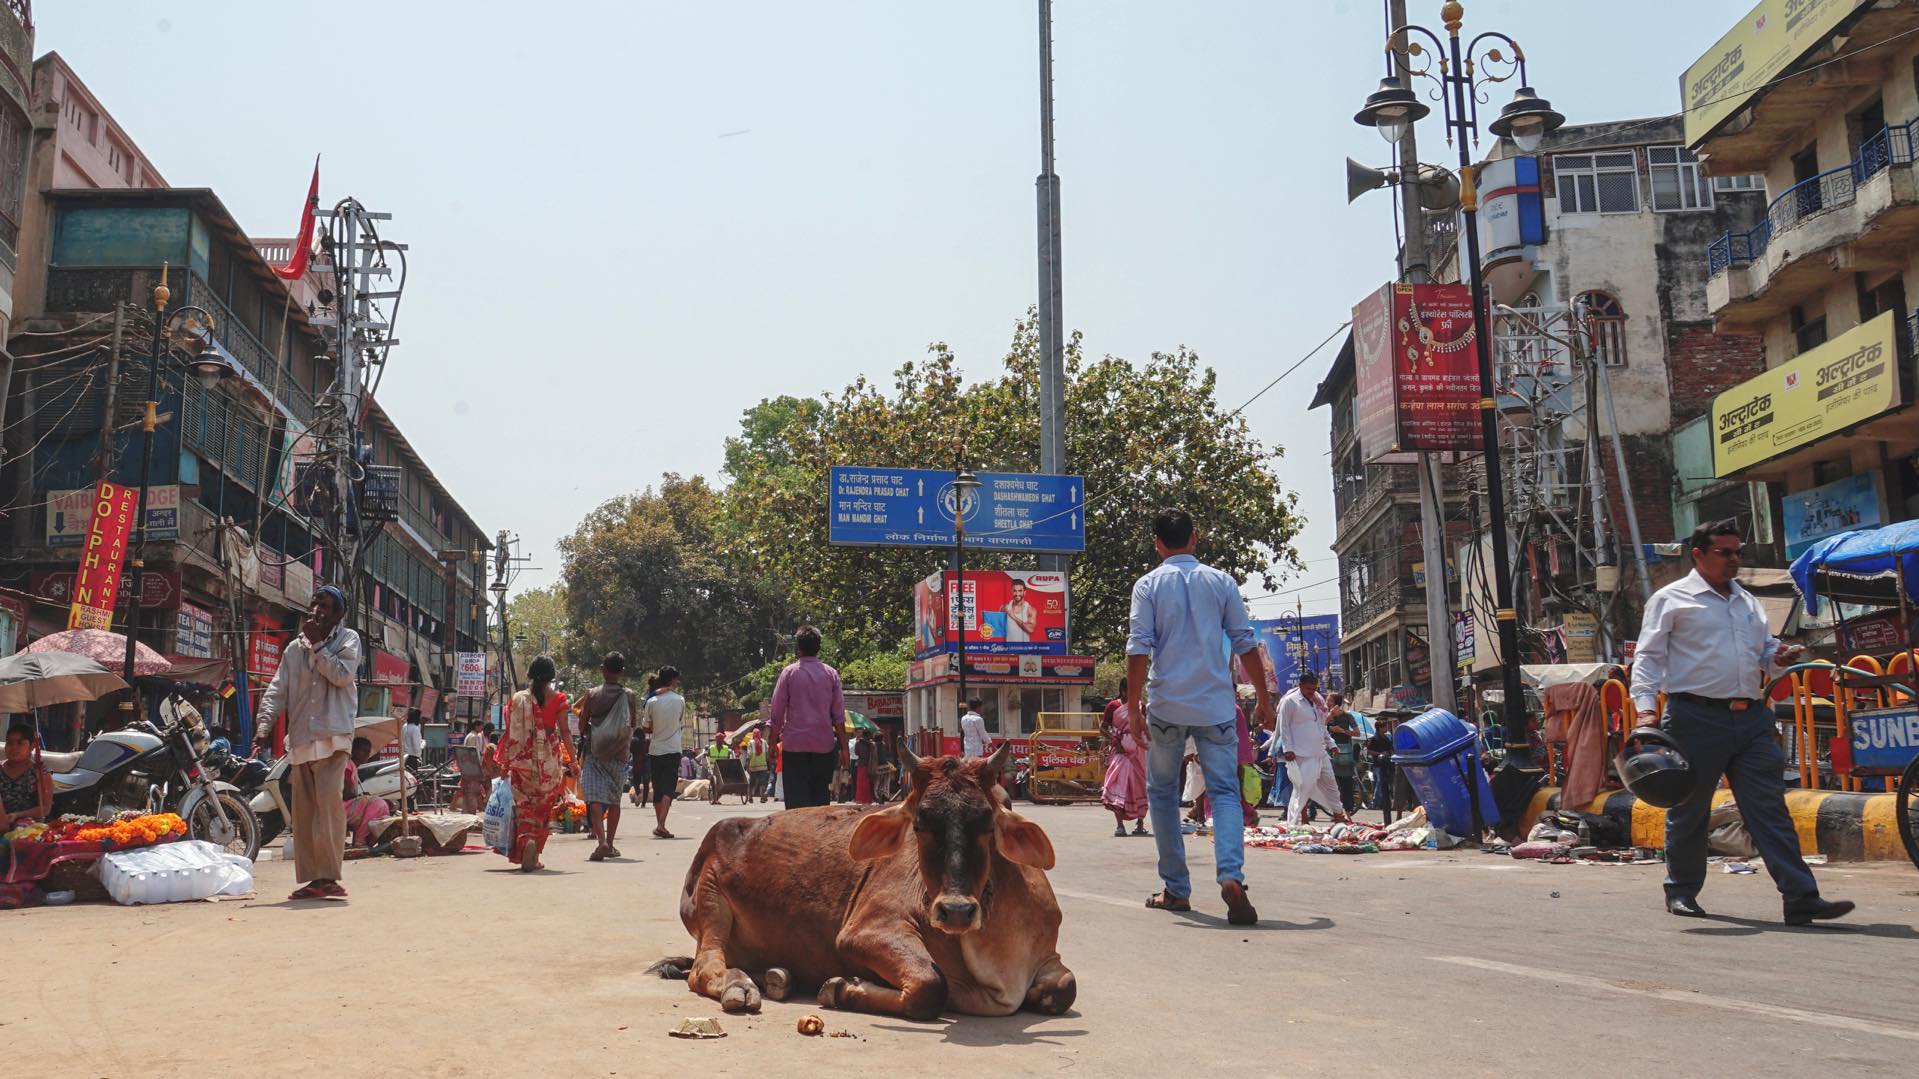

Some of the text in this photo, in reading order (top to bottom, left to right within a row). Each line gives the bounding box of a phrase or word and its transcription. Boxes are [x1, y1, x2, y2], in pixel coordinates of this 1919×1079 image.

[1816, 341, 1882, 387] अल्ट्राटेक
[1426, 402, 1444, 410] लाल
[1719, 393, 1771, 431] अल्ट्राटेक
[871, 475, 889, 485] प्रसाद
[890, 476, 903, 485] घाट
[1026, 481, 1039, 491] घाट
[846, 486, 872, 496] RAJENDRA
[873, 487, 894, 497] PRASAD
[895, 487, 909, 497] GHAT
[1041, 493, 1056, 503] GHAT
[838, 498, 887, 512] मान मन्दिर घाट
[994, 503, 1029, 518] शीतला घाट
[838, 513, 887, 524] MAN MANDIR GHAT
[994, 519, 1017, 529] SHEETLA
[78, 483, 114, 605] DOLPHIN
[884, 532, 911, 541] लोक
[913, 532, 948, 542] निर्माण
[988, 536, 1032, 545] वाराणसी
[100, 489, 132, 609] RESTAURANT
[951, 583, 974, 593] FEE
[80, 605, 111, 619] RASHMI
[80, 613, 107, 624] GUEST
[178, 613, 190, 627] TEA
[1042, 753, 1067, 767] पुलिस
